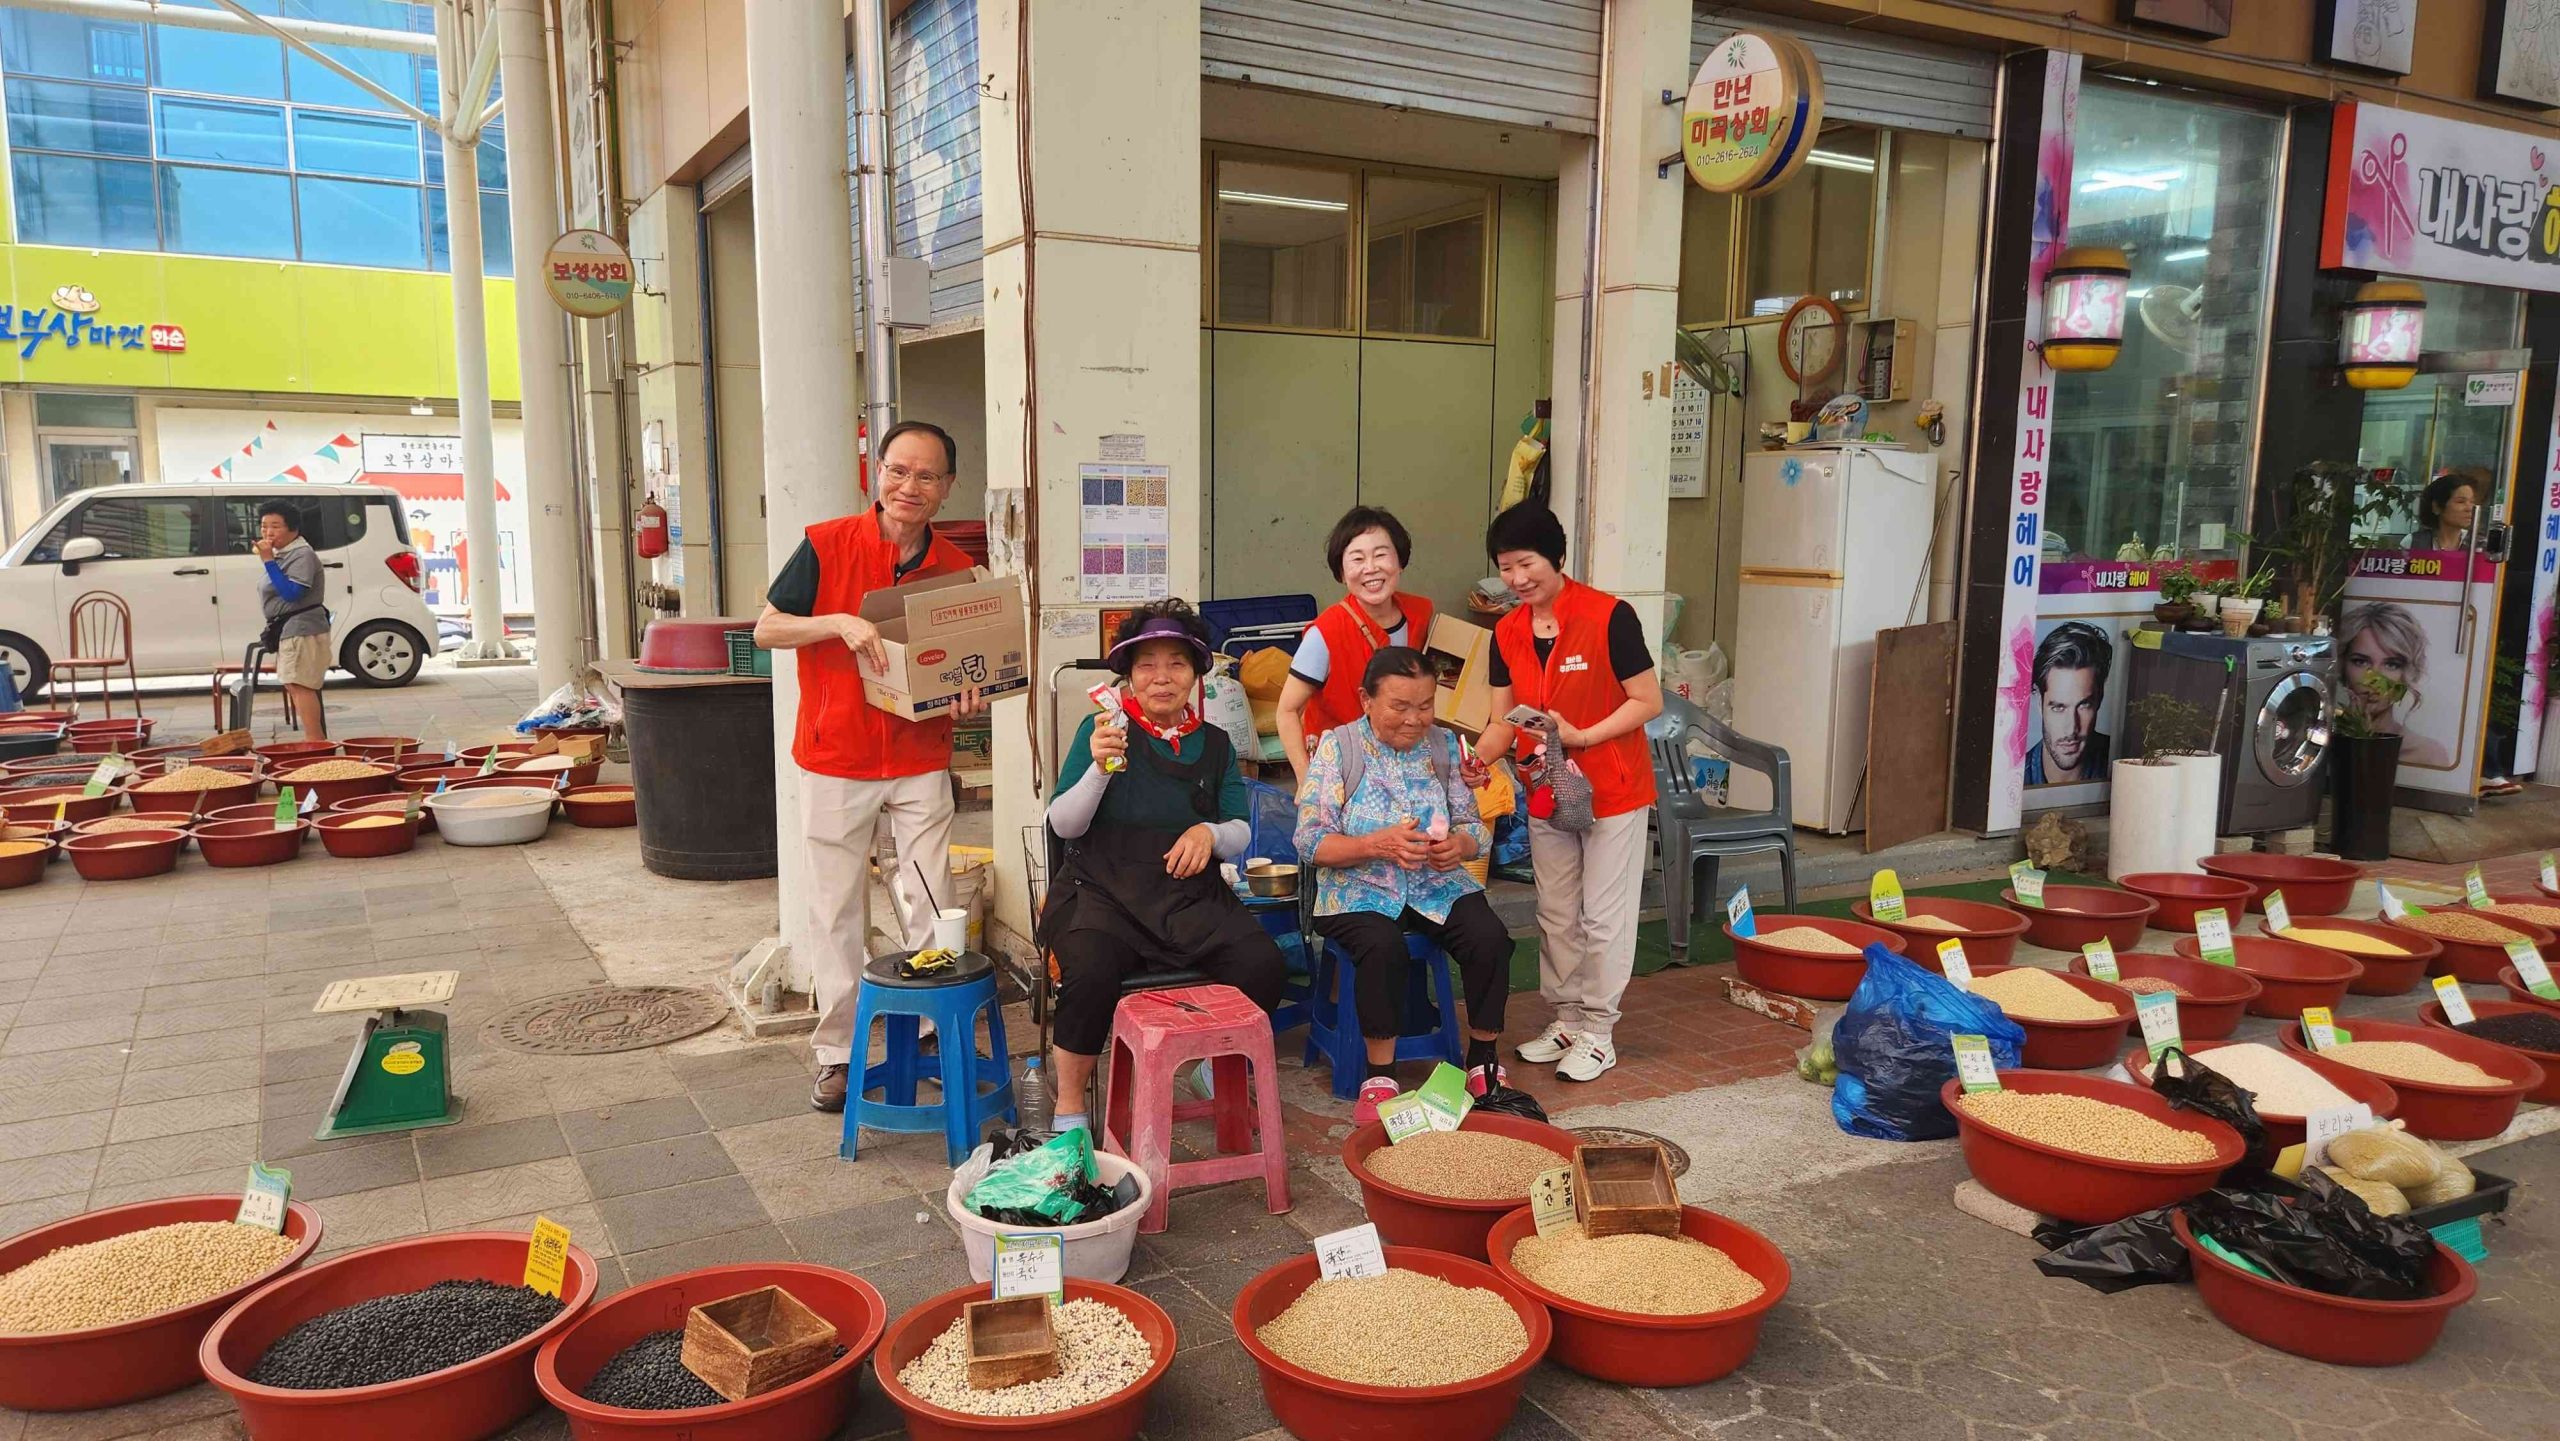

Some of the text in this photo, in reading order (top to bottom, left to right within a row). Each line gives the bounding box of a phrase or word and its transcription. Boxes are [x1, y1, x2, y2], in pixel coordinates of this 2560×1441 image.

[1714, 75, 1752, 110] 만년
[1691, 106, 1770, 147] 미곡상회
[2418, 167, 2540, 260] 내사랑
[1811, 310, 1817, 319] 12
[151, 328, 186, 348] 화순
[1690, 391, 1694, 399] 3
[1686, 418, 1693, 426] 17
[1694, 431, 1701, 439] 25
[384, 452, 464, 470] 보부상마
[2361, 557, 2442, 575] 내사랑 헤어
[2096, 570, 2150, 588] 내사랑 헤어
[2319, 1111, 2353, 1138] 보리쌀
[1017, 1250, 1045, 1265] 옥수수
[1325, 1246, 1346, 1266] 국산
[1016, 1265, 1037, 1280] 국산
